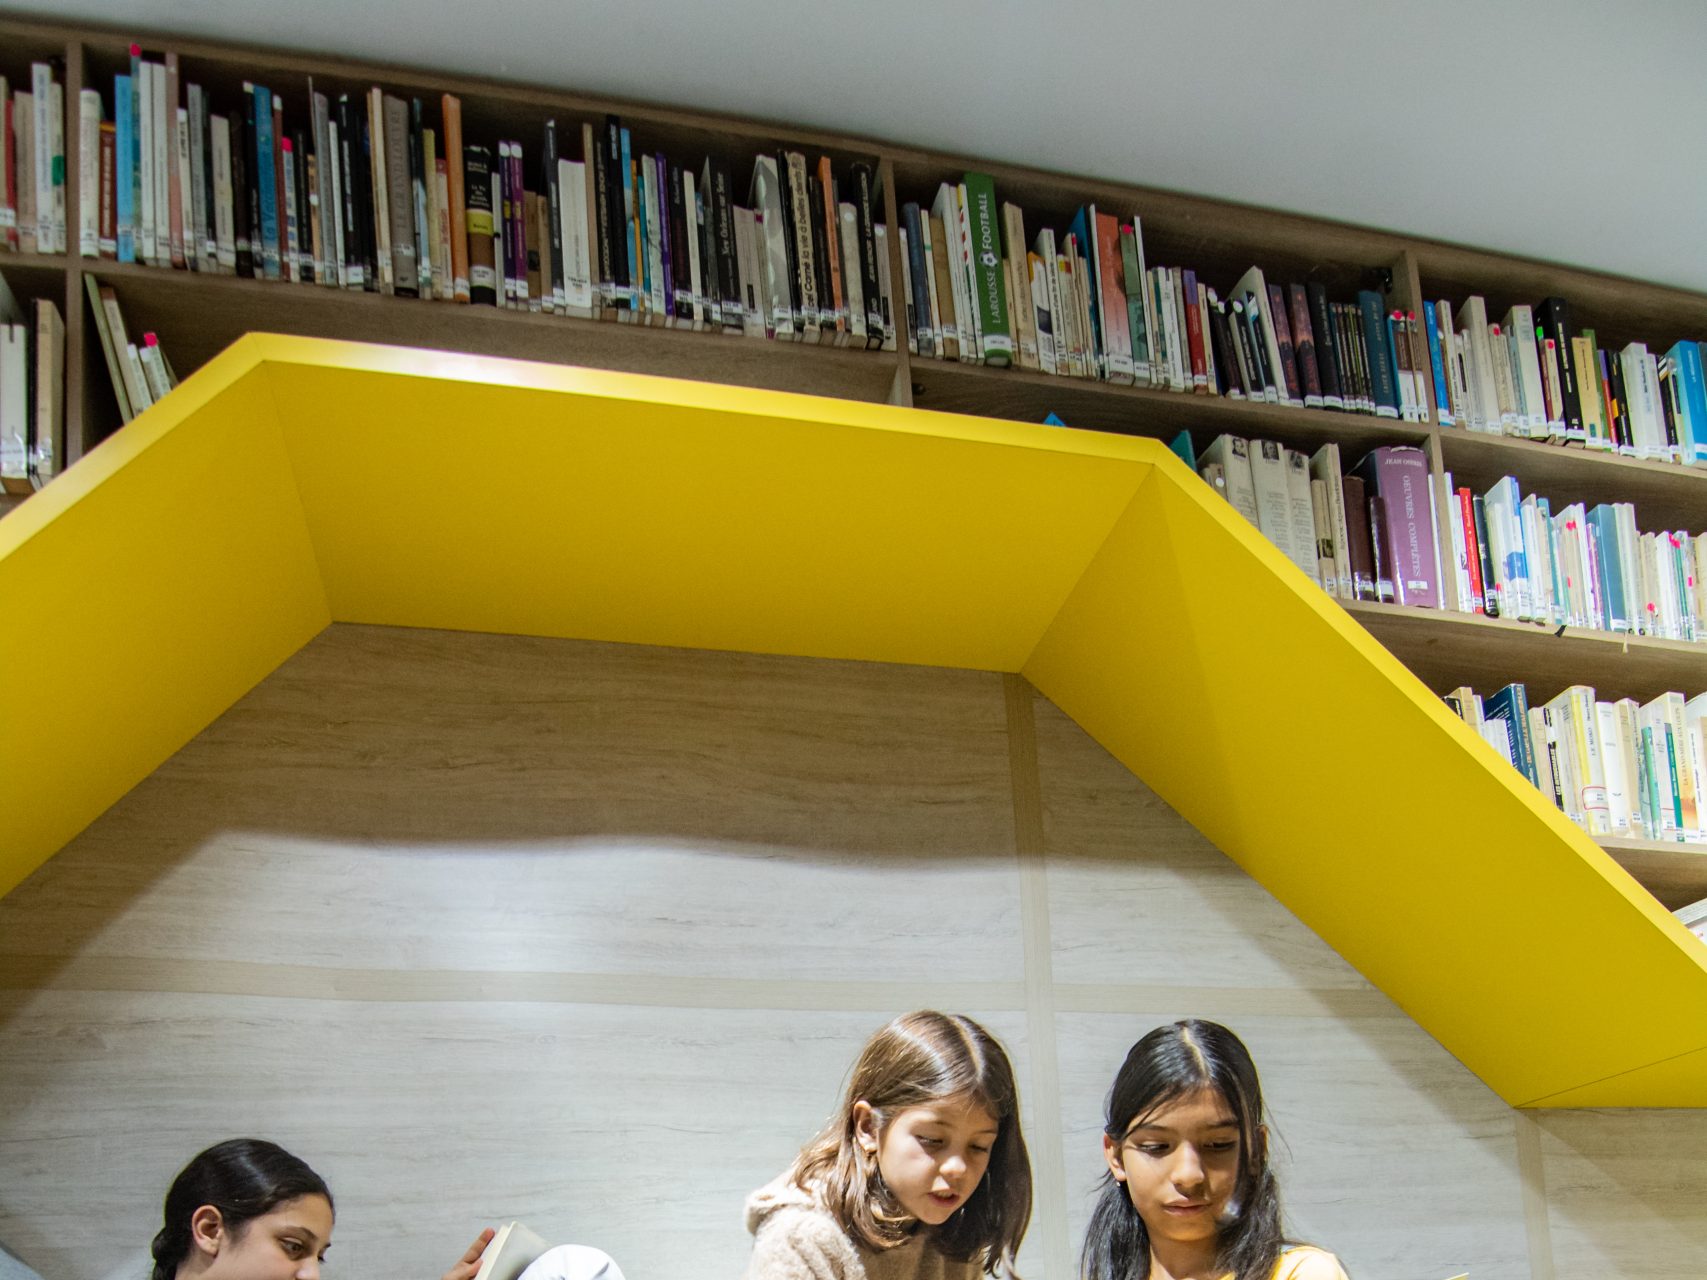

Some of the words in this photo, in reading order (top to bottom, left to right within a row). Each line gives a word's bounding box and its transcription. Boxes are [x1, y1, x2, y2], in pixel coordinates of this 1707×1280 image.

[793, 171, 804, 195] dents
[795, 198, 807, 224] belles
[976, 192, 992, 250] FOOTBALL
[799, 235, 809, 248] vie
[800, 250, 810, 259] la
[801, 261, 813, 291] Carné
[804, 292, 816, 325] Mcel
[985, 270, 1000, 323] LAROUSSE
[1401, 474, 1414, 518] OEUVRES
